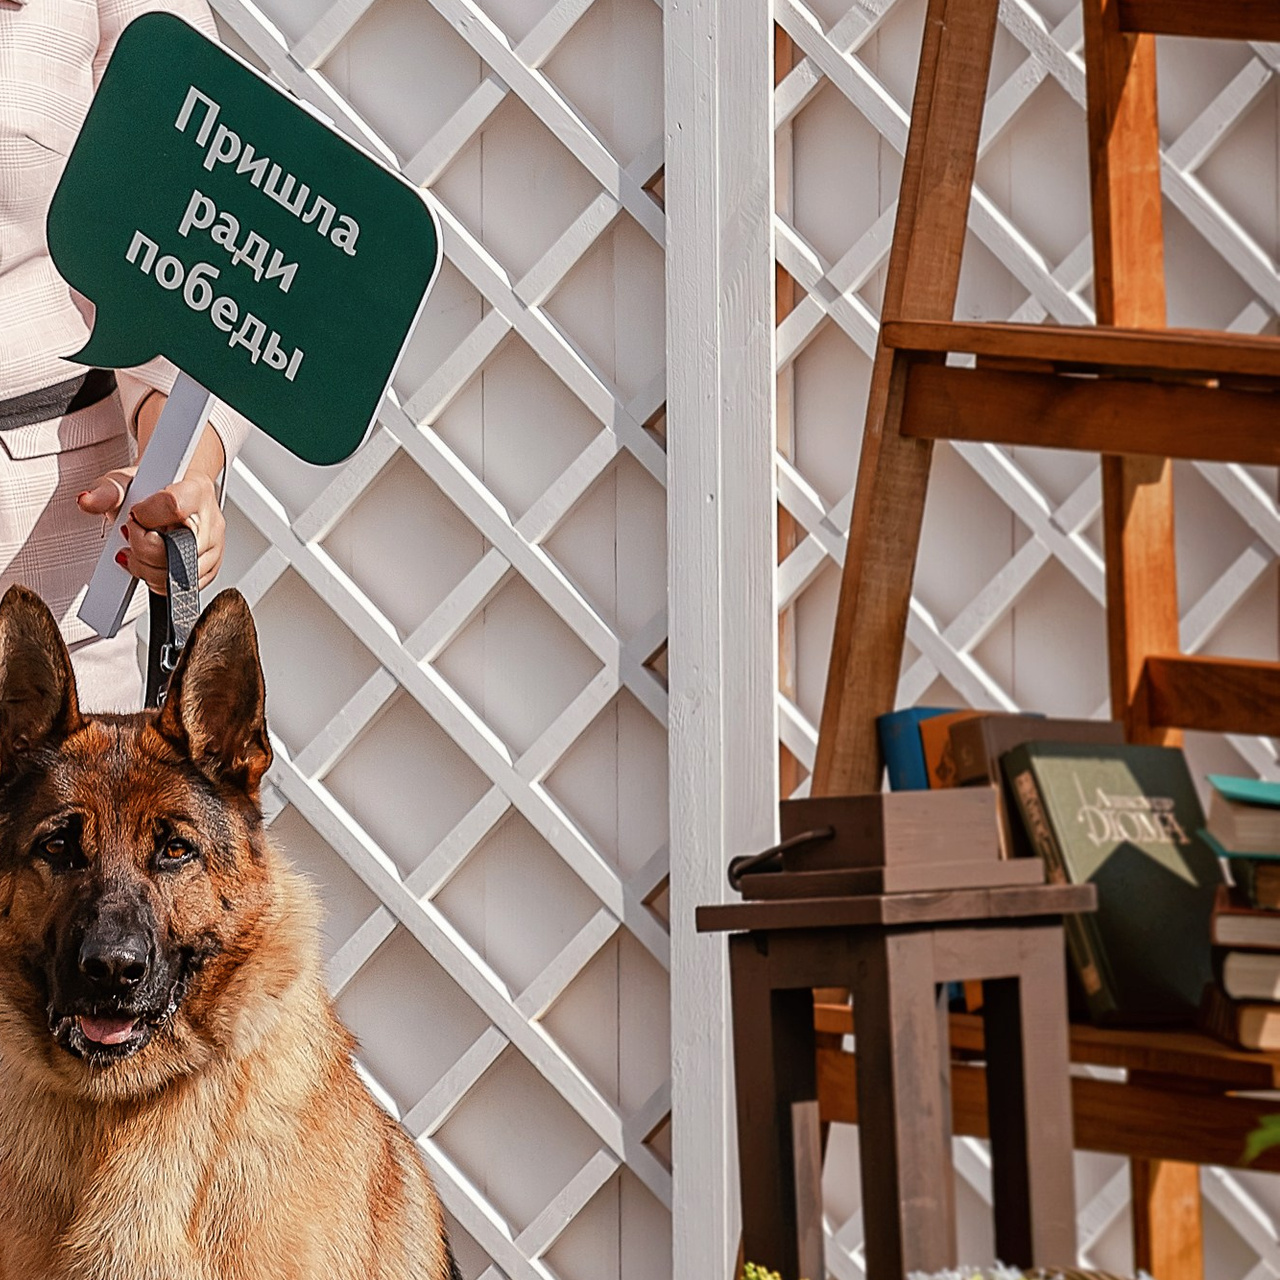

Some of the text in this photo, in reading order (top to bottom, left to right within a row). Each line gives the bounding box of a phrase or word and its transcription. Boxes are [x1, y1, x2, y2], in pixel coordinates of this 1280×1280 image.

[174, 85, 361, 257] Пришла
[178, 189, 299, 293] ради
[125, 229, 304, 382] победы
